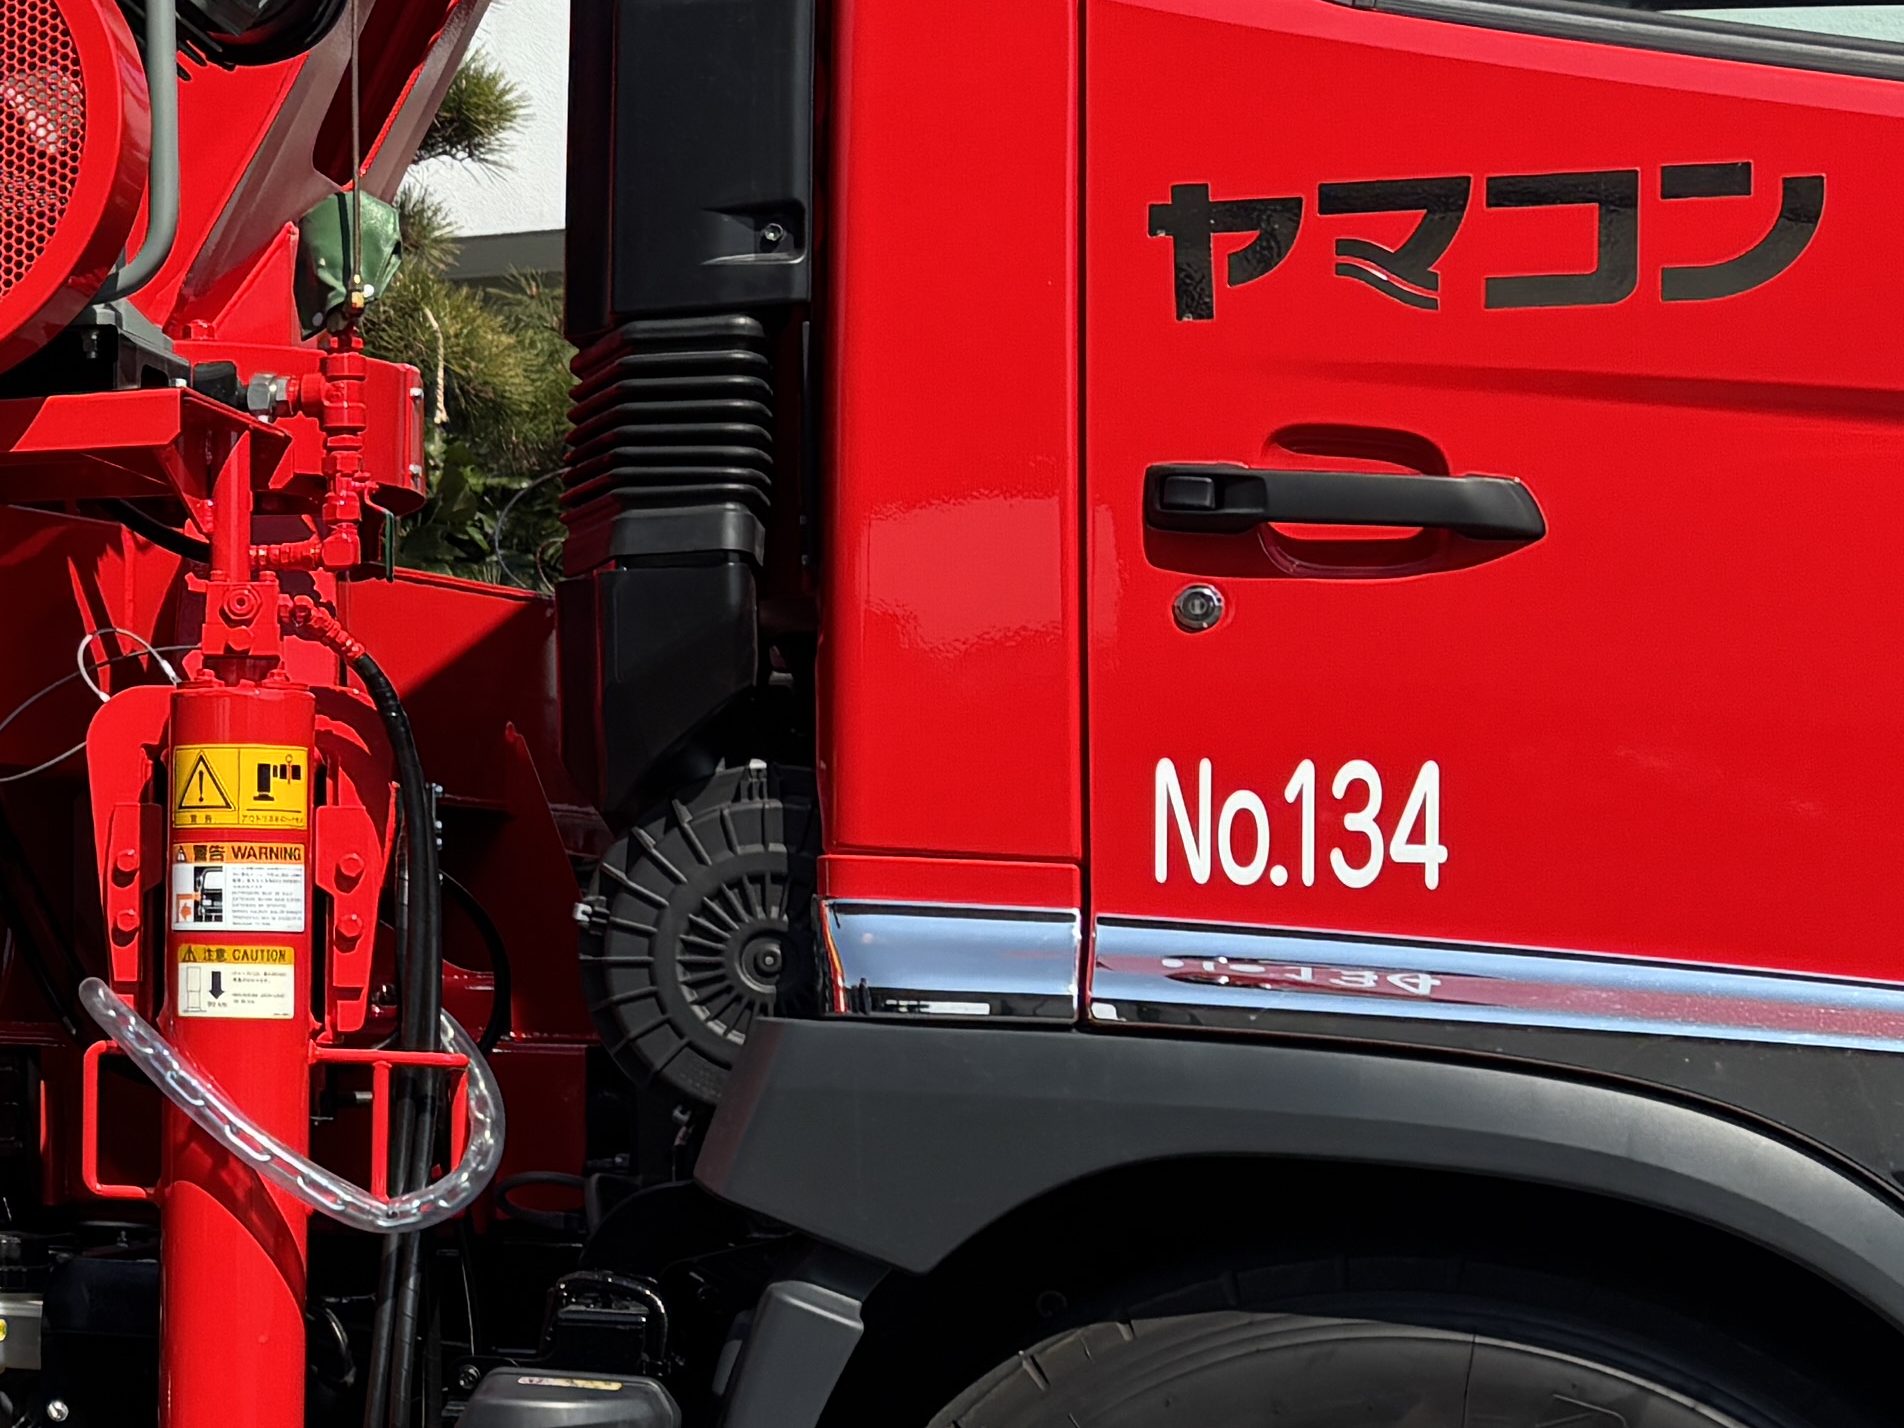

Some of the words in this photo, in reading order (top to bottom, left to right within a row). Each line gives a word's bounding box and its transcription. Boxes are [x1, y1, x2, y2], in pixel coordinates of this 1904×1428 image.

[1148, 160, 1826, 322] ヤマコン
[231, 845, 301, 861] WARNING
[1154, 756, 1449, 891] No.134
[232, 949, 286, 962] CAUTION
